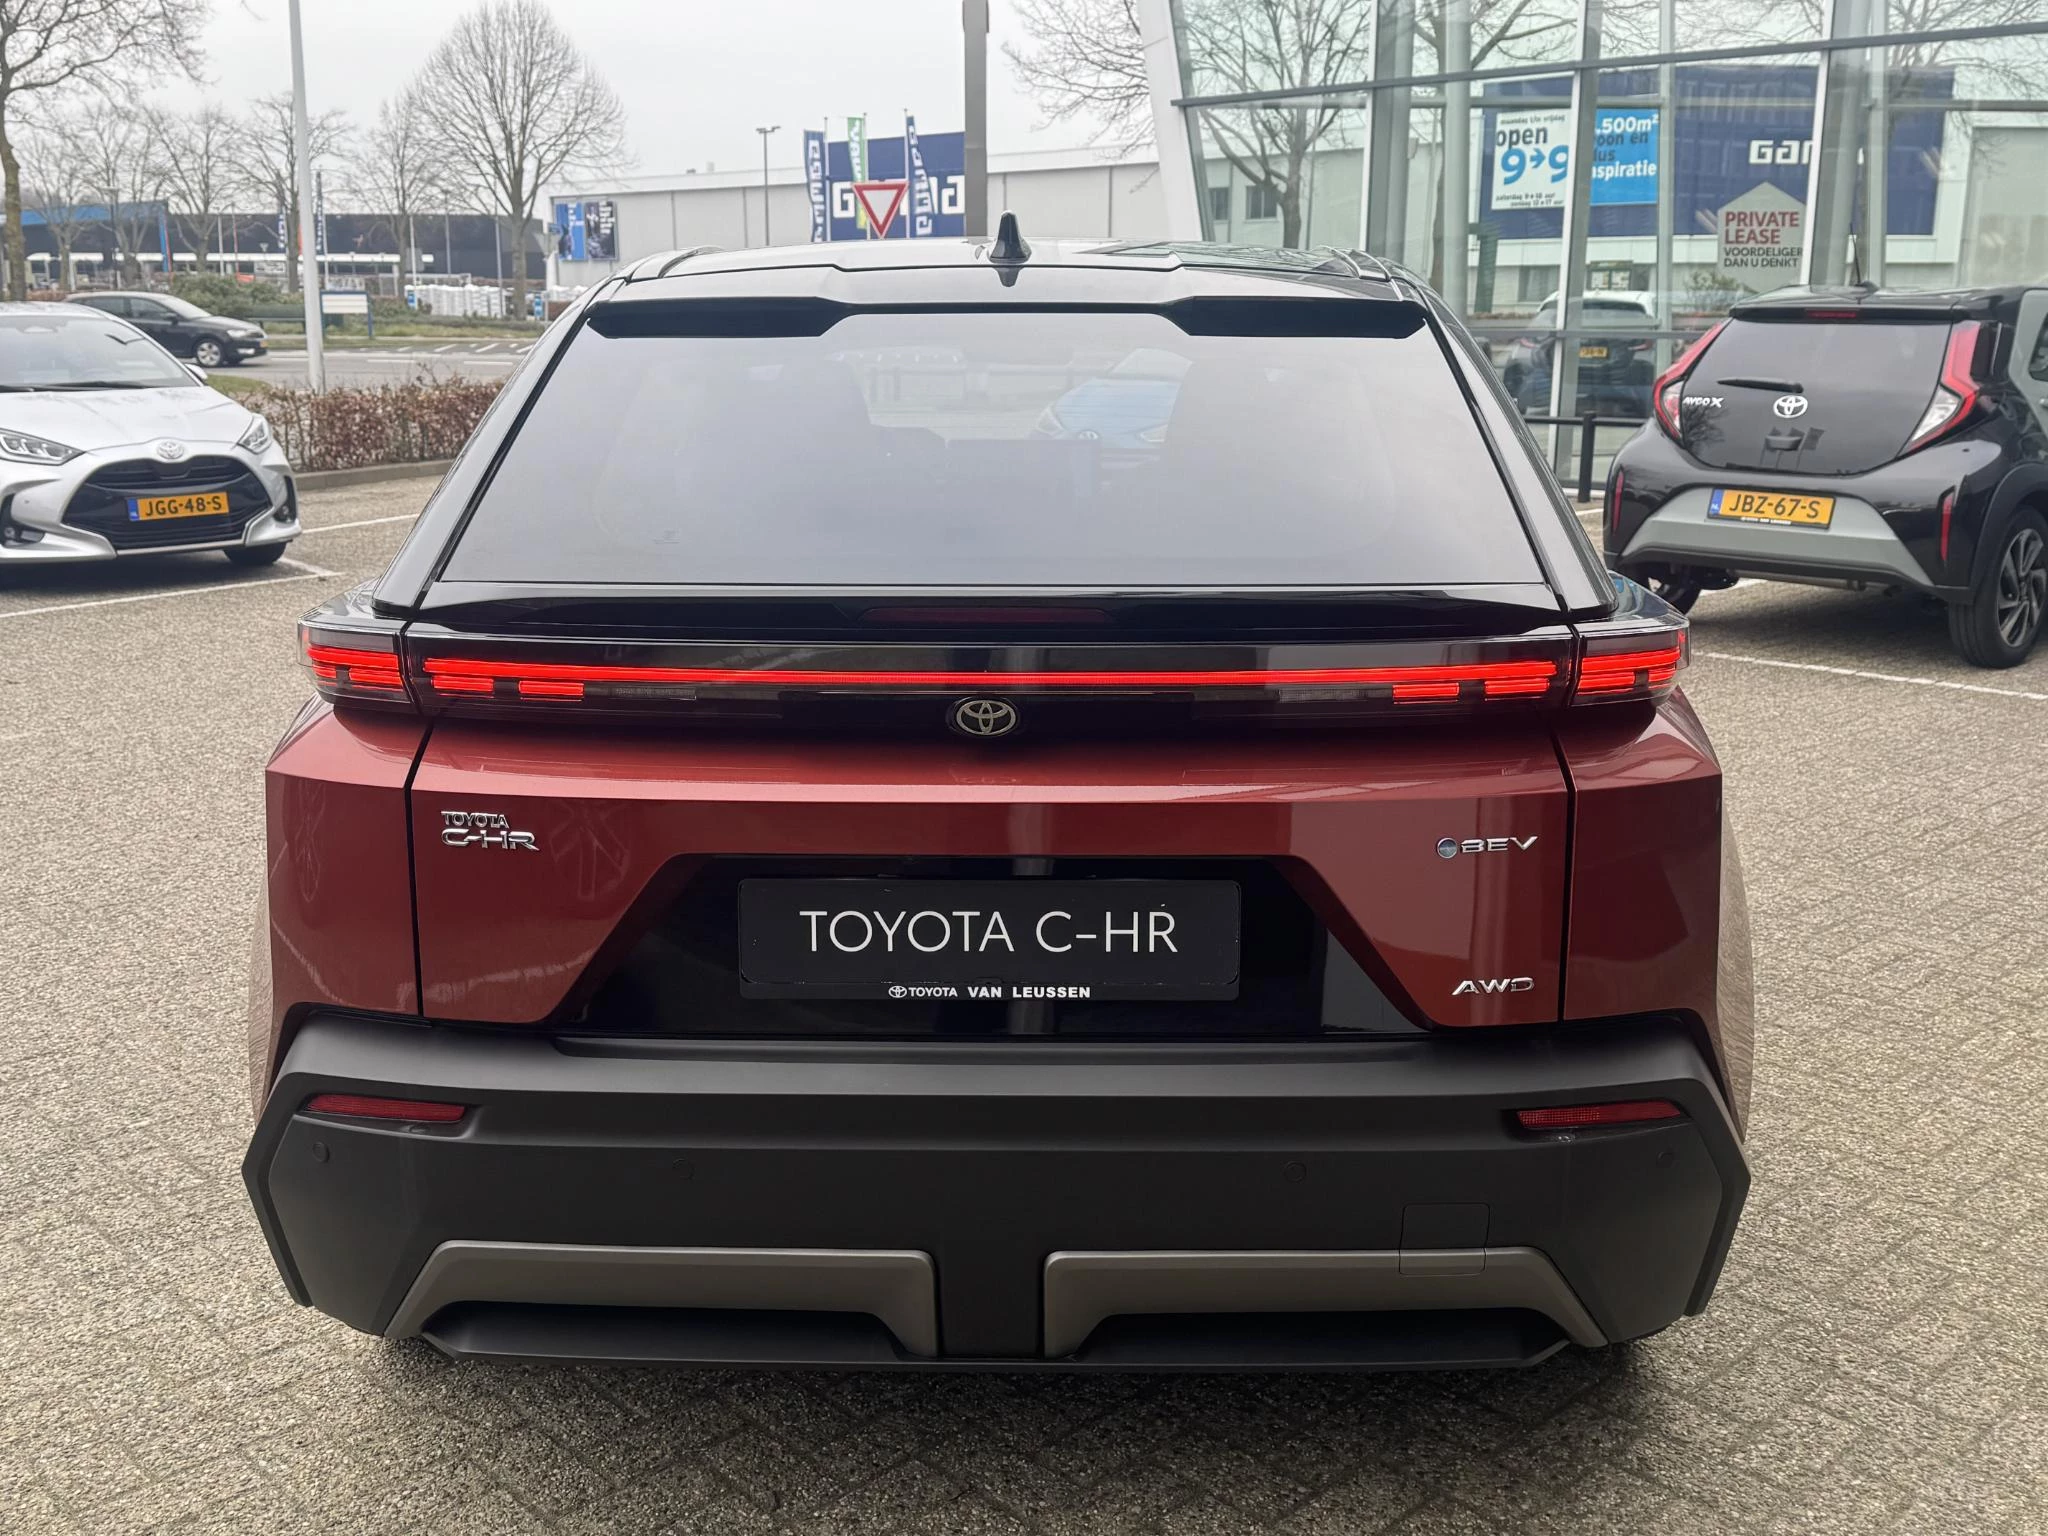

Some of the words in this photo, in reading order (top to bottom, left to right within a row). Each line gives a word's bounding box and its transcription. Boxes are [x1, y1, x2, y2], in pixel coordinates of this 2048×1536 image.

[1595, 113, 1659, 134] .500m²
[1497, 127, 1548, 150] open
[1725, 211, 1799, 227] PRIVATE
[1725, 228, 1781, 244] LEASE
[1724, 246, 1803, 257] VOORDELIGER
[1724, 258, 1748, 267] DAN
[1751, 258, 1759, 267] U
[1761, 257, 1797, 267] DENKT
[145, 495, 222, 516] JGG-48-S
[1729, 494, 1821, 519] JBZ-67-S
[441, 811, 509, 828] TOYOTA
[441, 828, 540, 851] C-HR
[1461, 836, 1538, 853] BEV
[799, 911, 1015, 952] TOYOTA
[1036, 911, 1178, 952] C-HR
[908, 986, 958, 998] TOYOTA
[968, 986, 1002, 998] VAN
[1013, 986, 1090, 998] LEUSSEN
[1452, 977, 1534, 996] AWD
